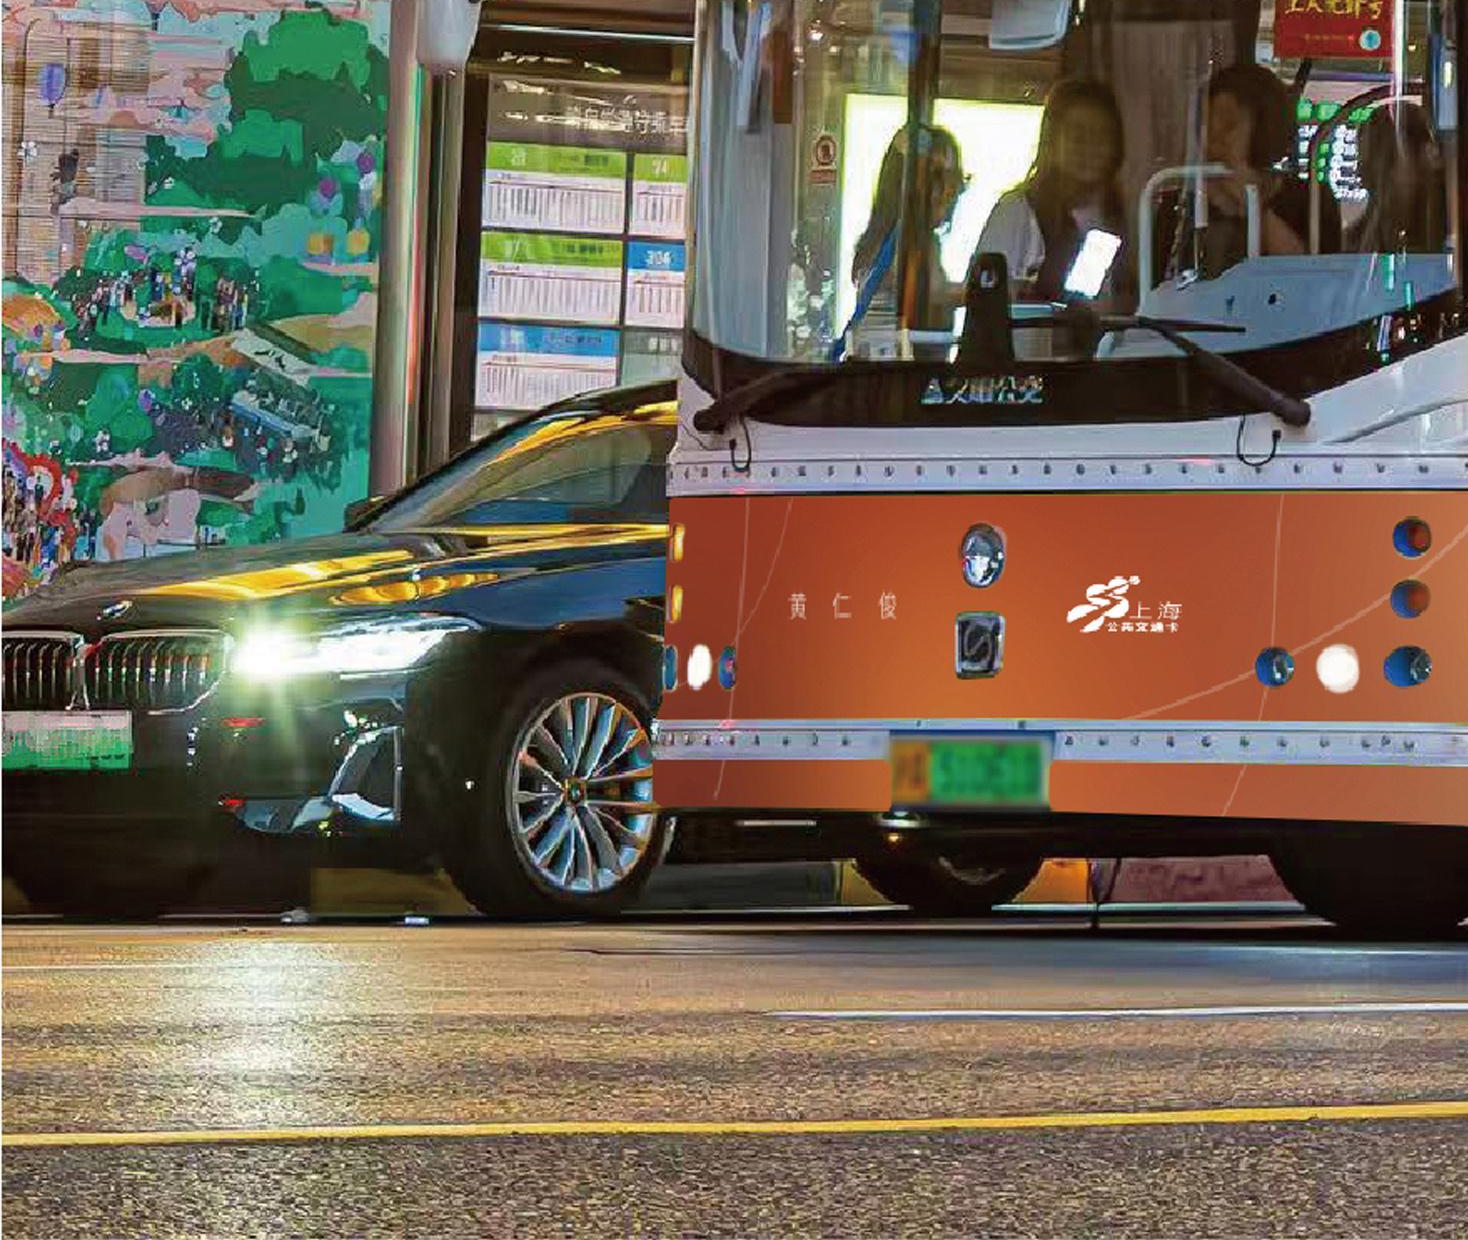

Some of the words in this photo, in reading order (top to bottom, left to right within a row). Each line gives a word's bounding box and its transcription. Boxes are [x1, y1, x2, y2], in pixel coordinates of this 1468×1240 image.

[787, 591, 897, 621] 黄仁俊
[1129, 600, 1183, 620] 上海
